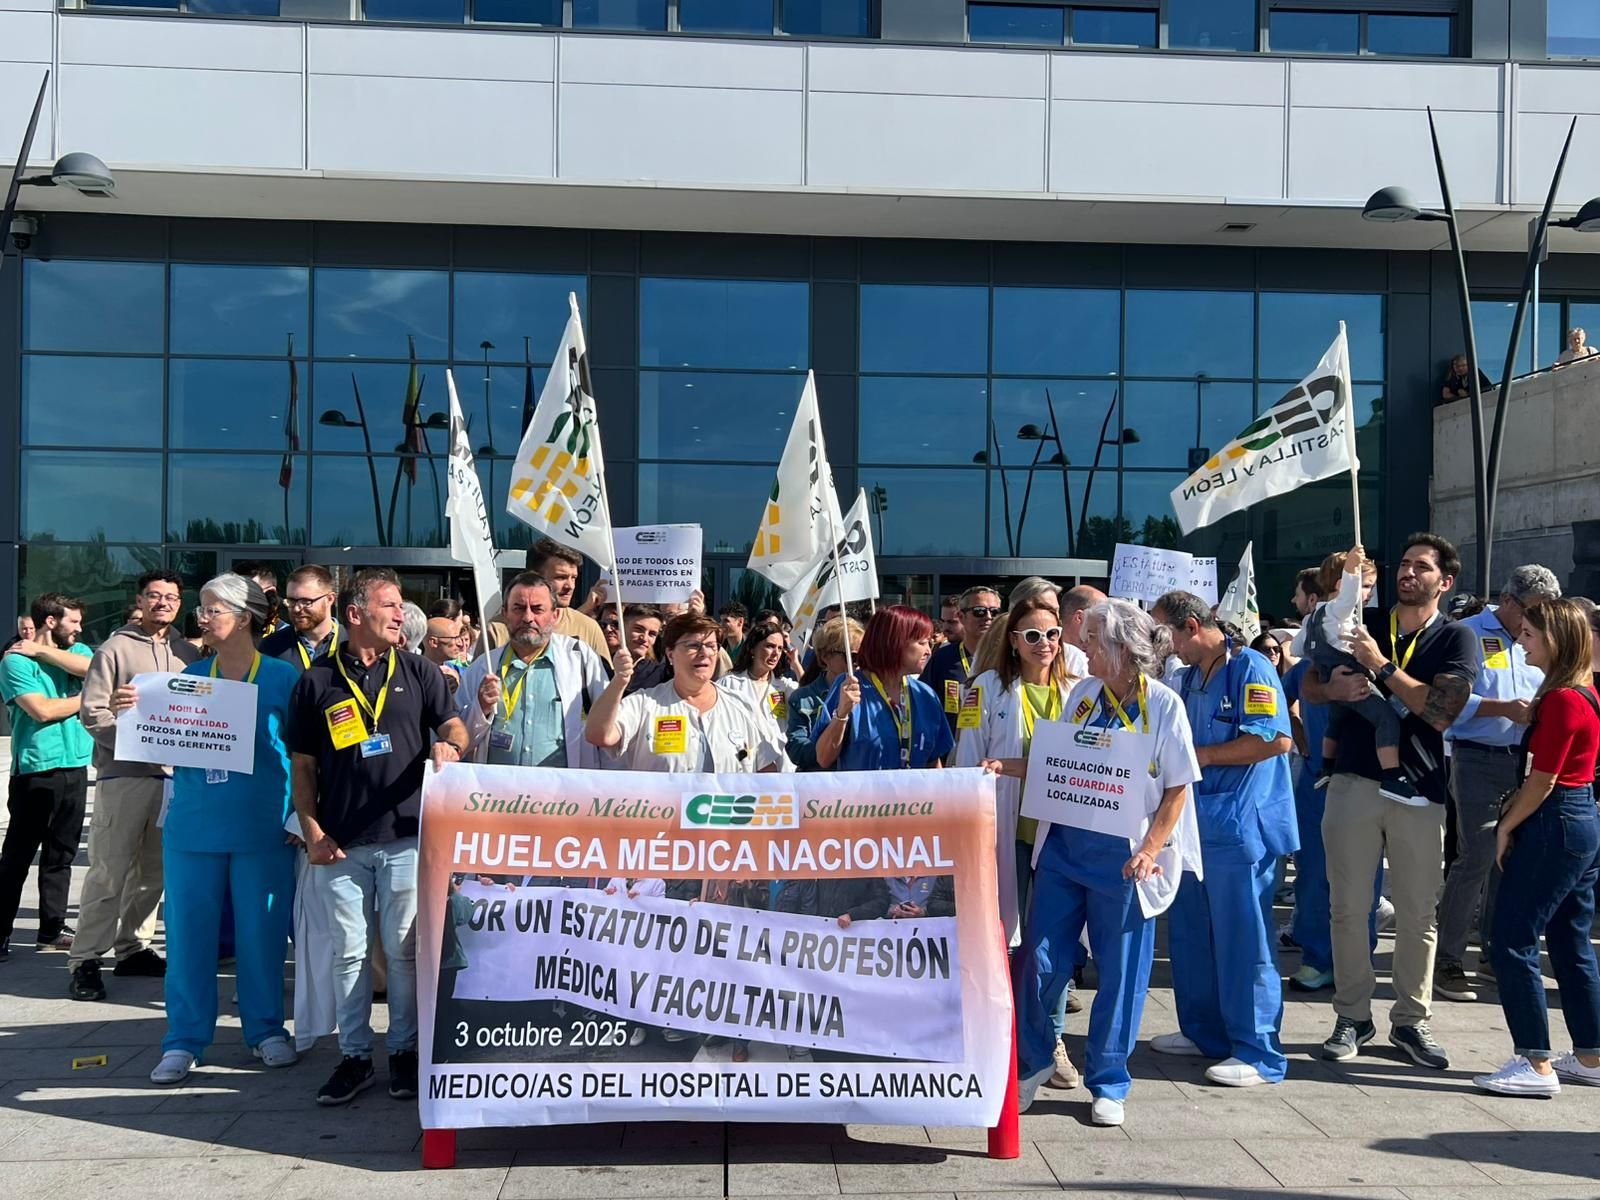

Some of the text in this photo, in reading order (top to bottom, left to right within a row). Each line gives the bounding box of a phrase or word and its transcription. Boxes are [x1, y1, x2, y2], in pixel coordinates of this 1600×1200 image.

[614, 557, 630, 565] AGO
[632, 557, 643, 565] DE
[645, 557, 674, 565] TODOS
[168, 704, 208, 714] NO!!! LA
[136, 723, 237, 741] FORZOSA EN MANOS
[159, 715, 171, 723] LA
[173, 716, 229, 729] MOVILIDAD
[141, 736, 231, 752] DE LOS GERENTES
[1046, 756, 1131, 779] REGULACIÓN DE
[1047, 772, 1124, 795] LAS GUARDIAS
[463, 792, 934, 825] Sindicato Médico CESM Salamanca
[1047, 789, 1120, 811] LOCALIZADAS
[453, 831, 954, 872] HUELGA MÉDICA NACIONAL
[467, 898, 951, 980] OR UN ESTATUTO DE LA PROFESIÓN
[534, 949, 845, 1038] MÉDICA Y FACULTATIVA
[455, 1021, 627, 1047] 3 octubre 2025
[429, 1073, 983, 1099] MEDICO/AS DEL HOSPITAL DE SALAMANCA
